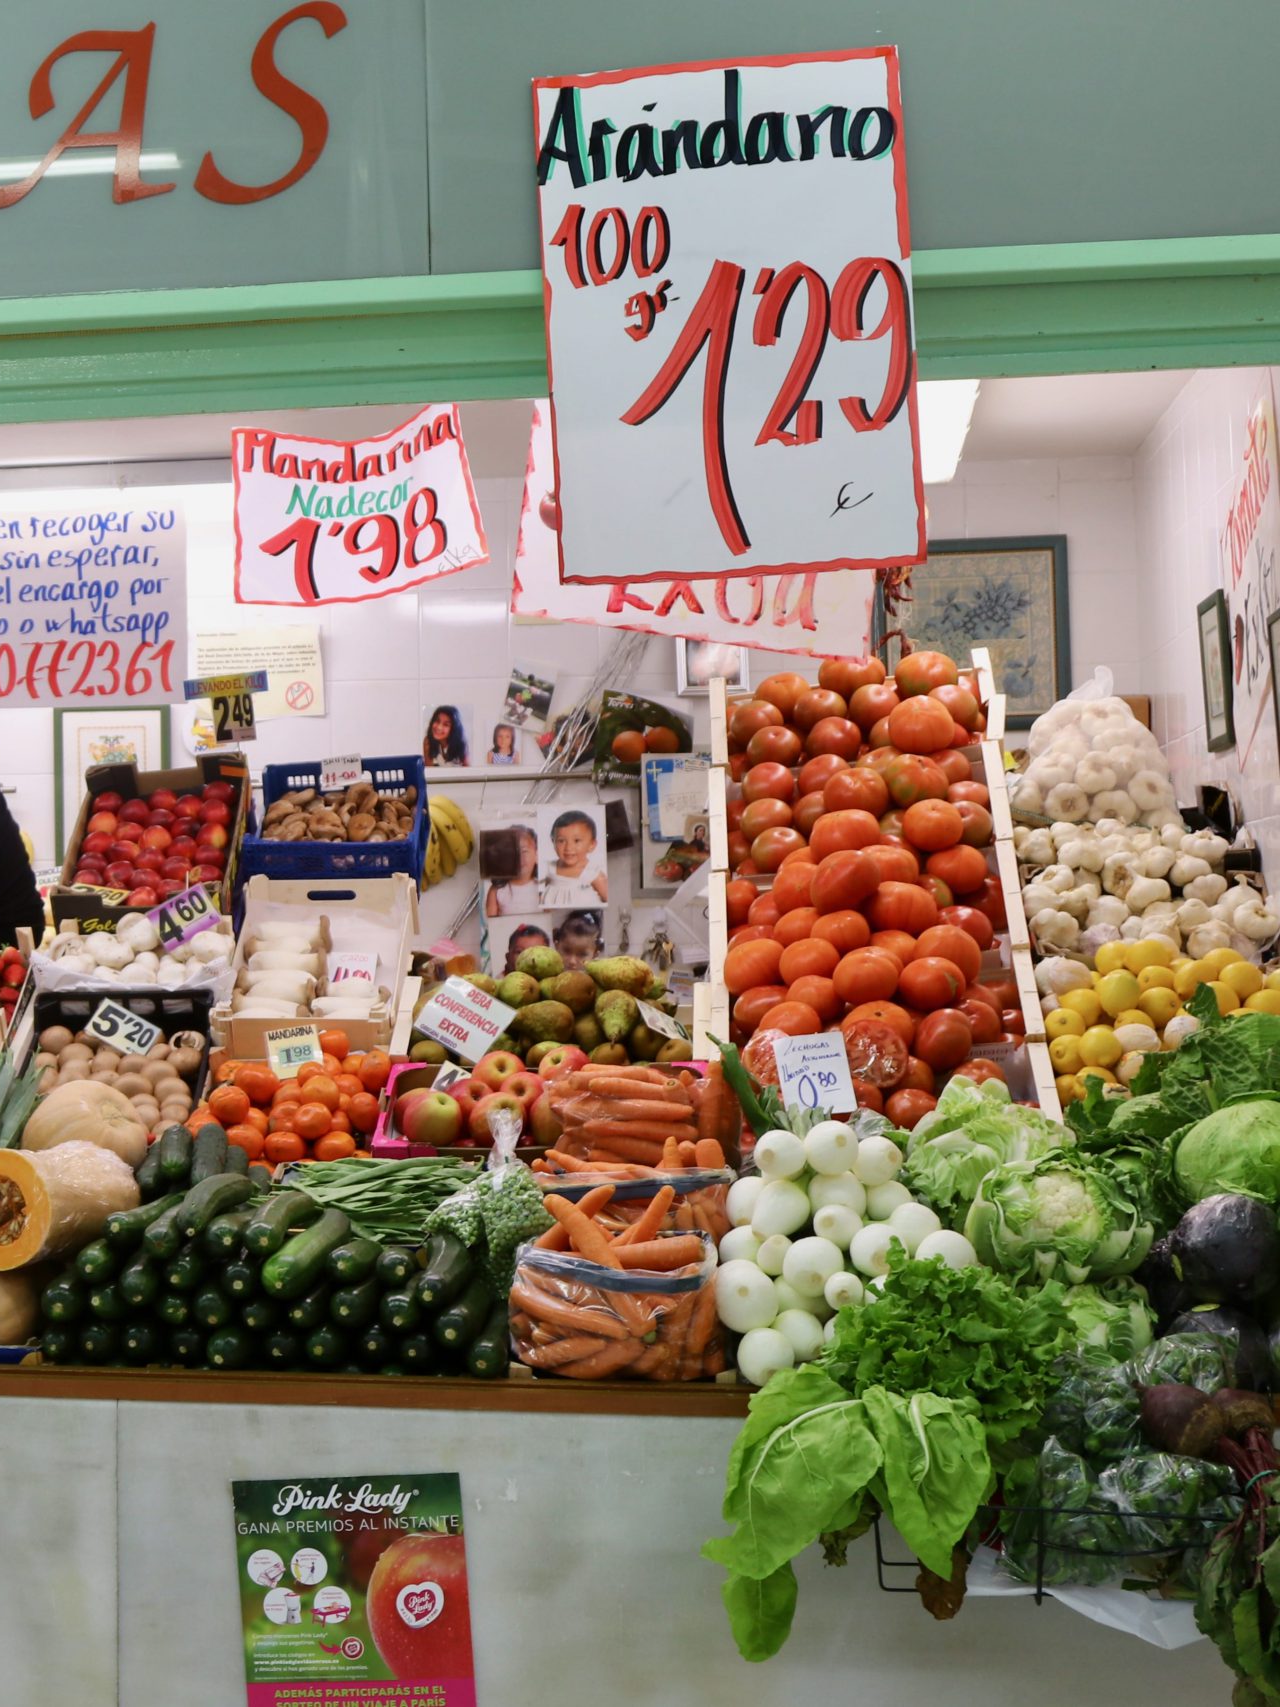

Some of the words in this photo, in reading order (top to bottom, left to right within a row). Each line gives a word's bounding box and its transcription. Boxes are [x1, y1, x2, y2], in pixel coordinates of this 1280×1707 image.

[537, 68, 896, 189] Arándano
[549, 204, 671, 289] 100
[619, 256, 913, 556] 1'29
[242, 411, 457, 484] Mandarina
[29, 510, 134, 546] recoger
[141, 509, 175, 534] su
[258, 486, 448, 603] 1'98
[0, 550, 41, 571] sin
[47, 545, 160, 581] esperar,
[19, 577, 120, 613] encargo
[129, 576, 170, 606] por
[19, 616, 35, 634] o
[44, 602, 170, 645] whatsapp
[187, 677, 232, 696] LLEVANDO
[233, 676, 244, 688] EL
[245, 672, 264, 687] KILO
[159, 890, 208, 944] 4'60
[434, 992, 500, 1037] CONFERENCIA
[467, 989, 493, 1011] PERA
[91, 1003, 156, 1049] 5'20
[268, 1025, 314, 1041] MANDARINA
[437, 1016, 470, 1043] EXTRA
[280, 1044, 312, 1064] 1'98
[272, 1484, 344, 1516] Pink
[237, 1522, 281, 1535] GANA
[285, 1519, 355, 1533] PREMIOS
[359, 1518, 380, 1531] AL
[383, 1514, 460, 1530] INSTANTE
[274, 1686, 323, 1698] ADEMÁS
[325, 1684, 411, 1697] PARTICIPARÁS
[413, 1686, 429, 1695] EN
[432, 1685, 446, 1695] EL
